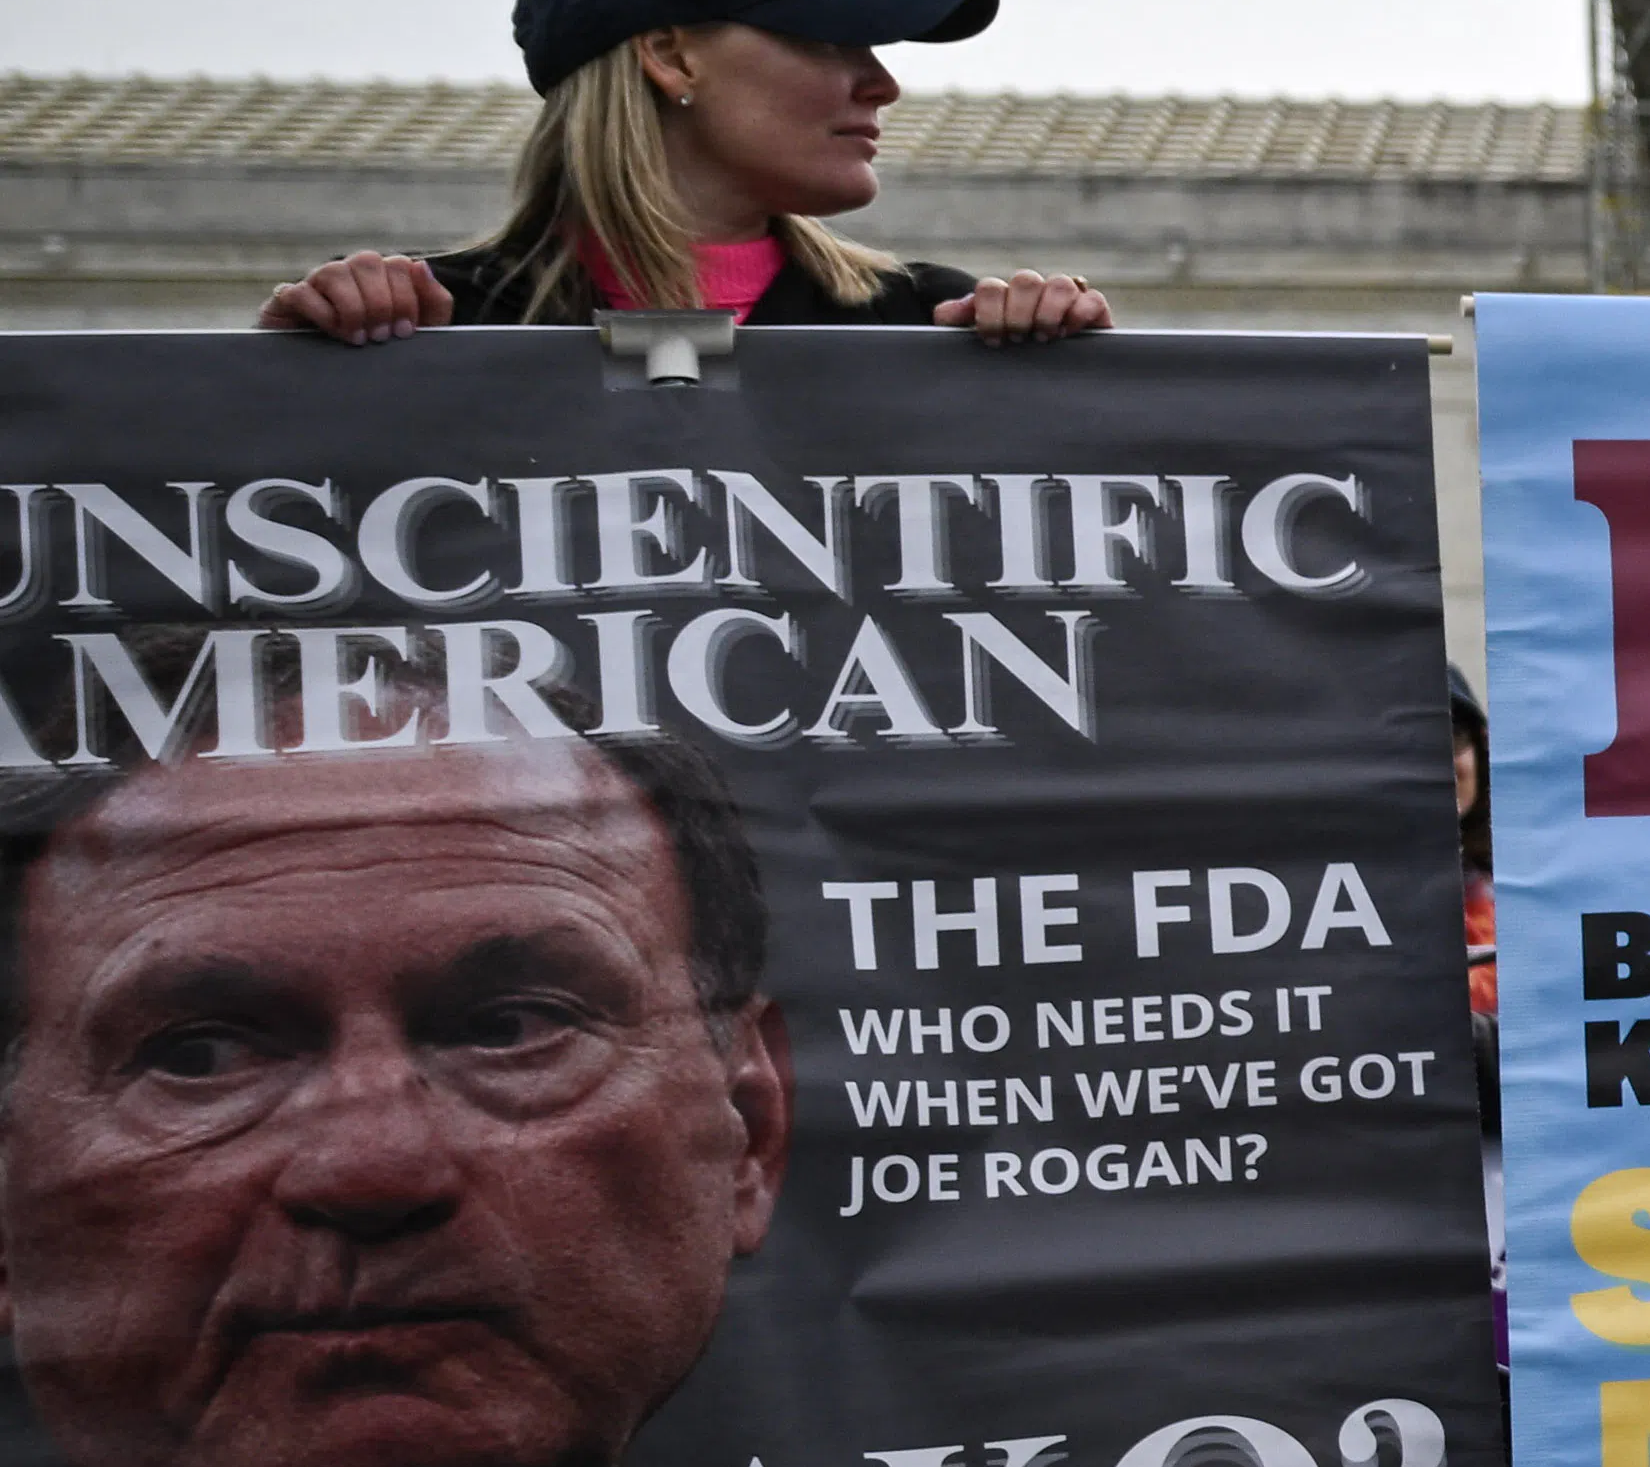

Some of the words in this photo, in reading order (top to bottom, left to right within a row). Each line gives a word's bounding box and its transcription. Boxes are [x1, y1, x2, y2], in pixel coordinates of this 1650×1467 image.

[822, 872, 1082, 970] THE
[1132, 862, 1392, 958] FDA
[840, 1003, 1008, 1055] WHO
[1037, 990, 1252, 1048] NEEDS
[1272, 985, 1333, 1033] IT
[846, 1074, 1056, 1128] WHEN
[1077, 1058, 1279, 1116] WE'VE
[1300, 1050, 1436, 1103] GOT
[840, 1155, 960, 1217] JOE
[983, 1133, 1269, 1200] ROGAN?
